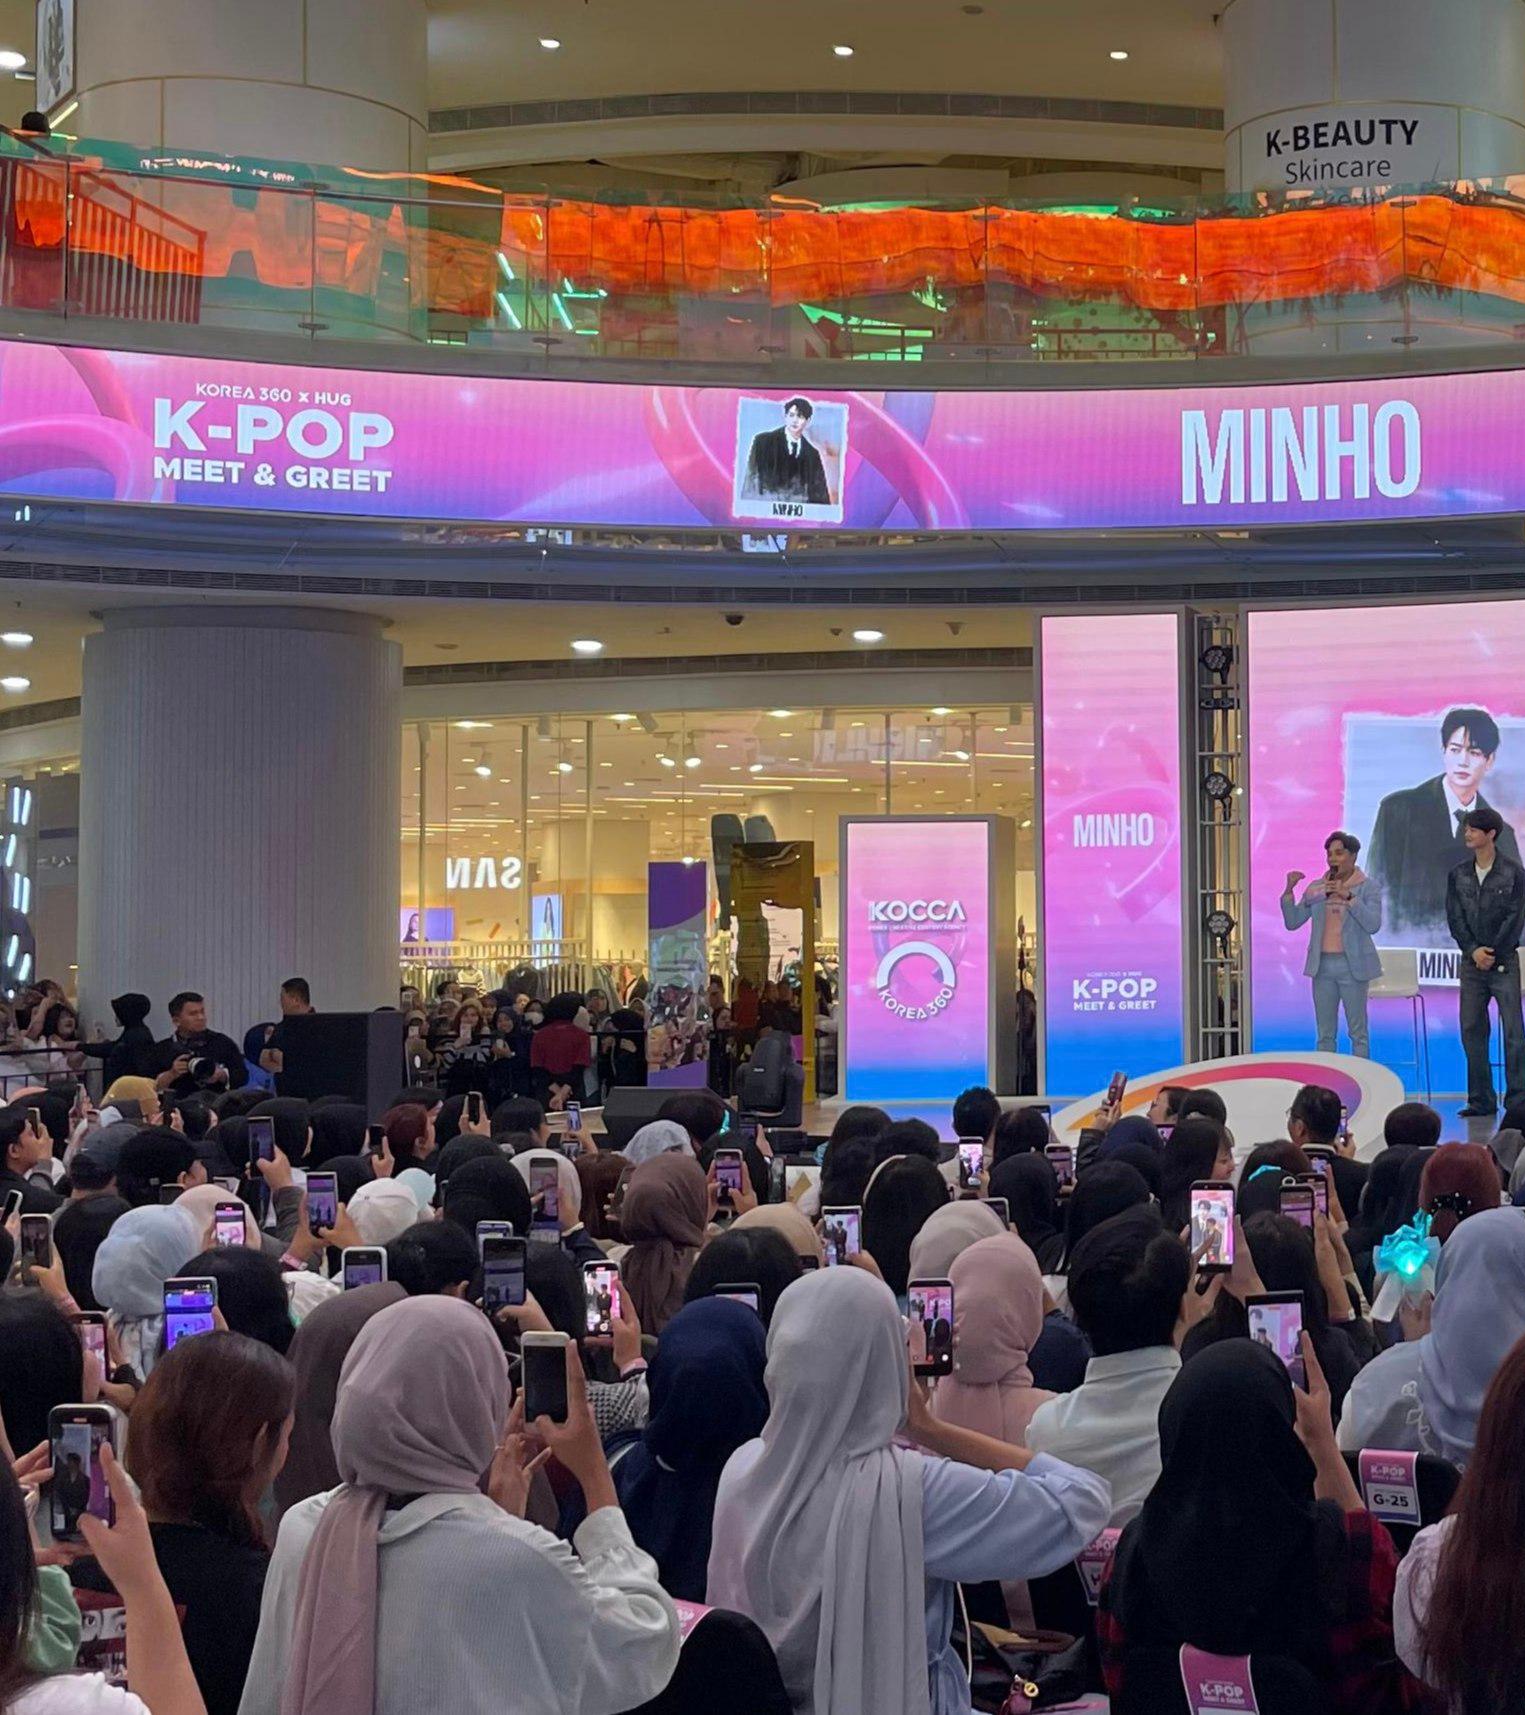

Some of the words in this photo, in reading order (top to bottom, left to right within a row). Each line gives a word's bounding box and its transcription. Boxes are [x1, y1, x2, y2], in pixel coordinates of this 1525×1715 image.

[1266, 119, 1419, 157] K-BEAUTY
[1286, 159, 1391, 184] Skincare
[196, 383, 255, 399] KOREA
[259, 388, 291, 402] 360
[314, 392, 351, 406] HUG
[154, 398, 394, 461] K-POP
[1182, 400, 1421, 504] MINHO
[153, 456, 245, 483] MEET
[253, 463, 276, 486] &
[285, 465, 392, 492] GREET
[1073, 812, 1154, 847] MINHO
[868, 900, 966, 921] KOCCA
[1073, 978, 1157, 999] K-POP
[878, 988, 927, 1019] KOREA
[926, 987, 953, 1016] 360
[1073, 1001, 1105, 1011] MEET
[1108, 1001, 1116, 1011] &
[1119, 1000, 1157, 1010] GREET
[1373, 1493, 1409, 1507] G-25
[1200, 1683, 1244, 1698] K-POP
